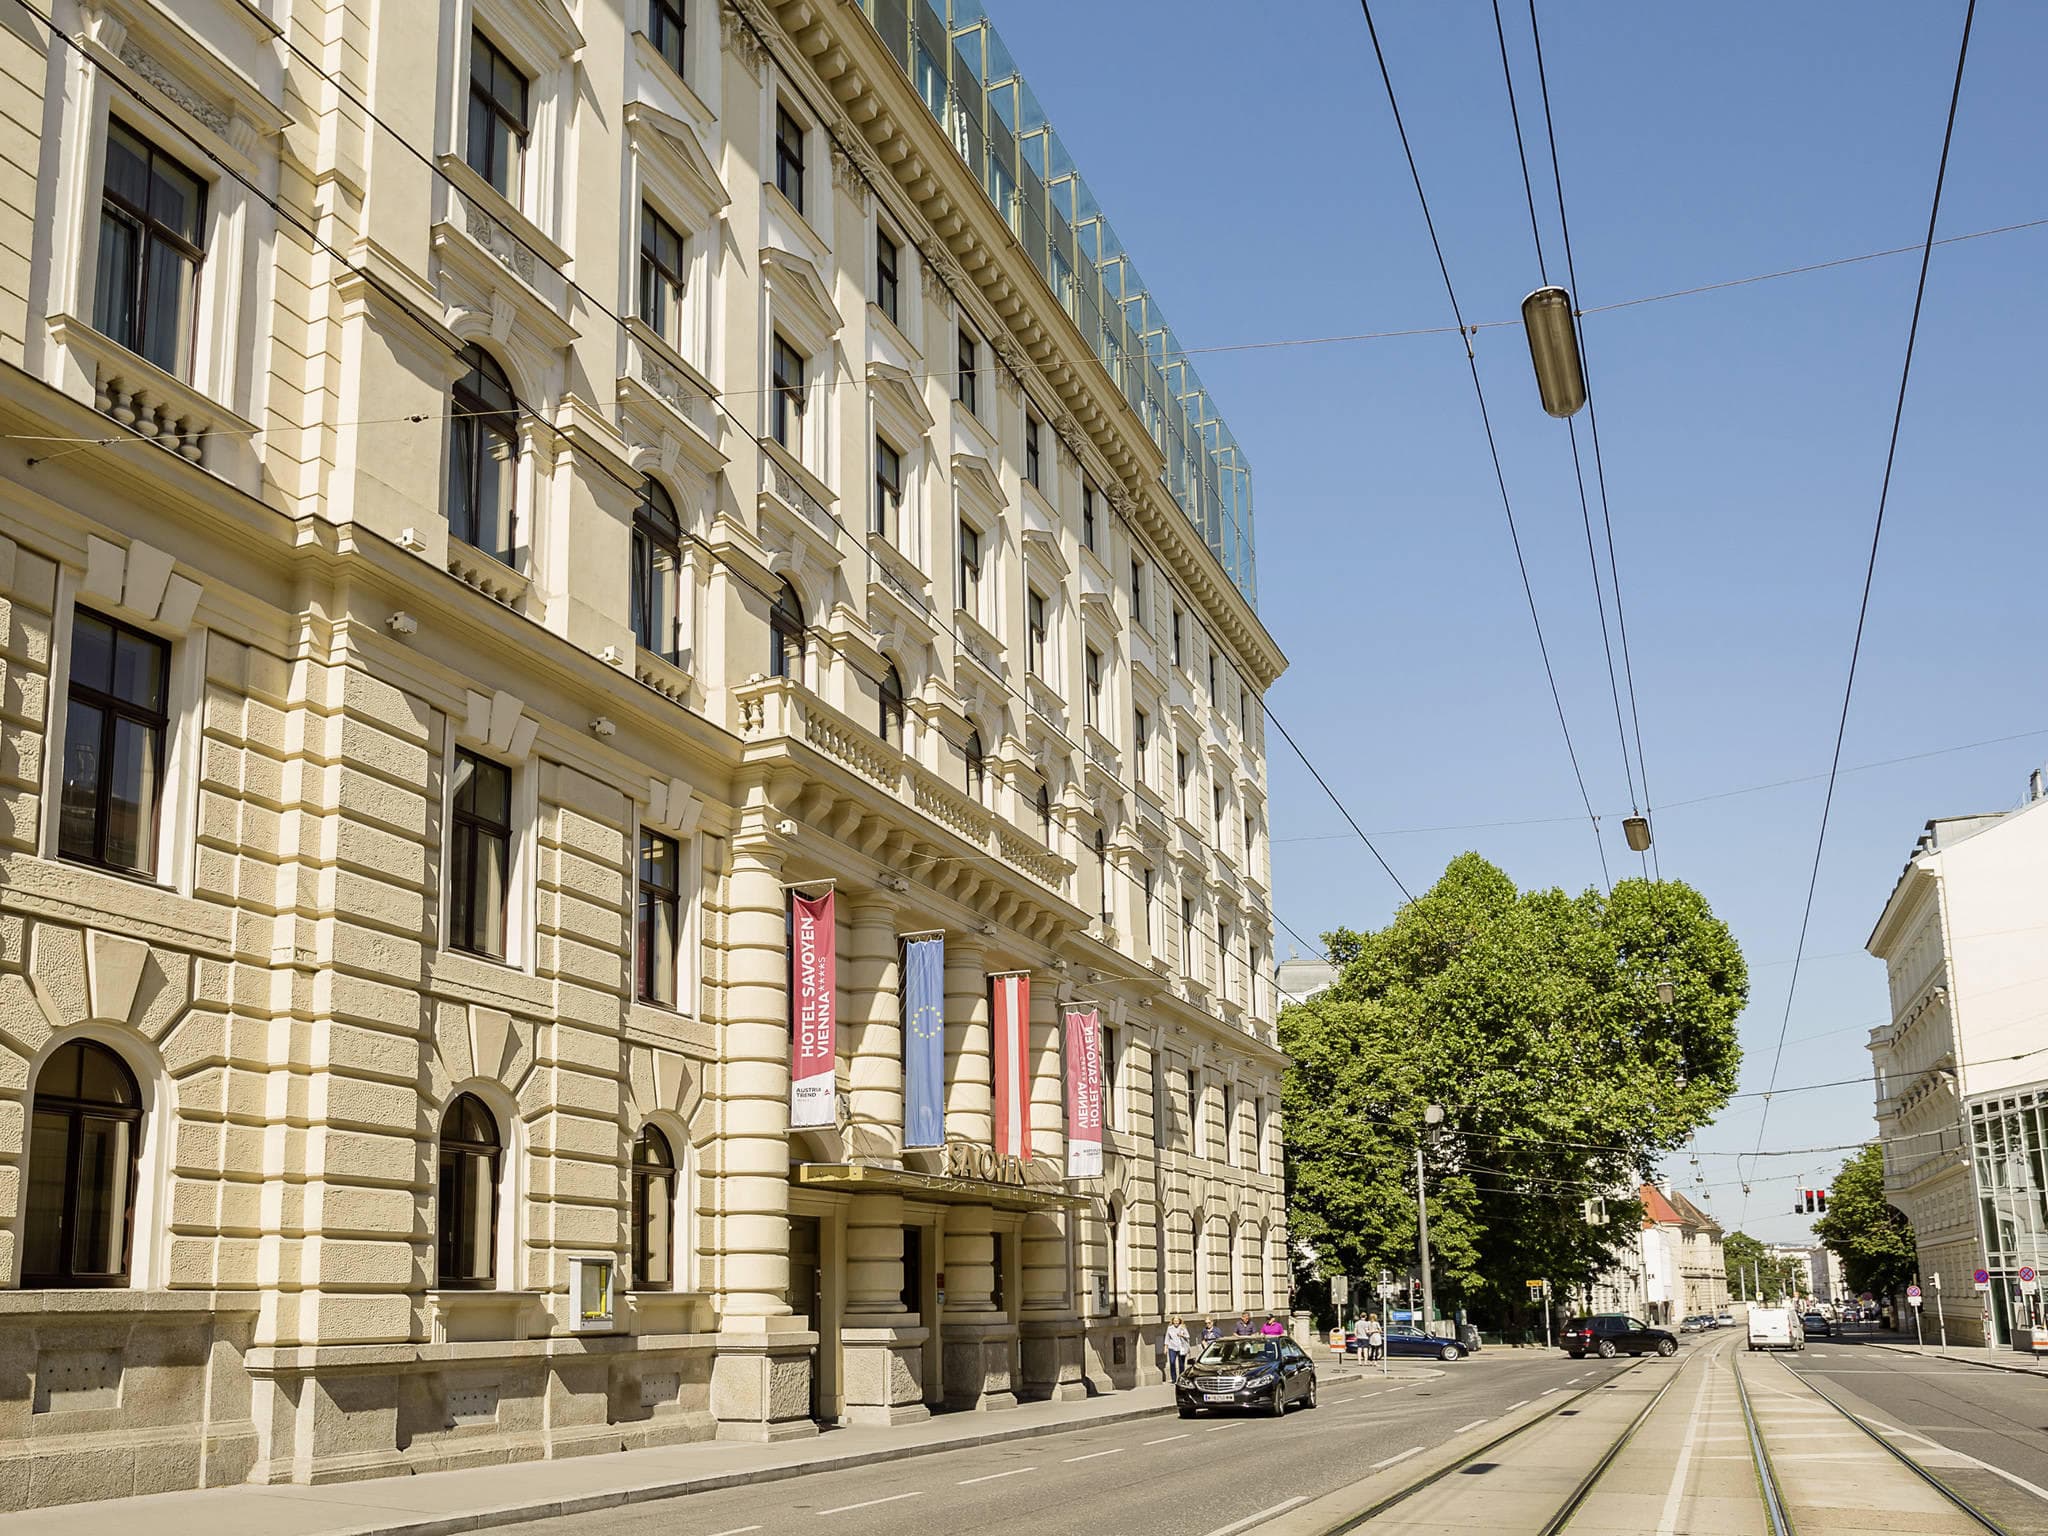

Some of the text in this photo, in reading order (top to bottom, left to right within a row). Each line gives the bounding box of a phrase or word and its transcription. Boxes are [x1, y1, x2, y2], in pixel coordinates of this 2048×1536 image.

[801, 917, 815, 1058] HOTEL SAVOYEN
[817, 991, 830, 1058] VIENNA
